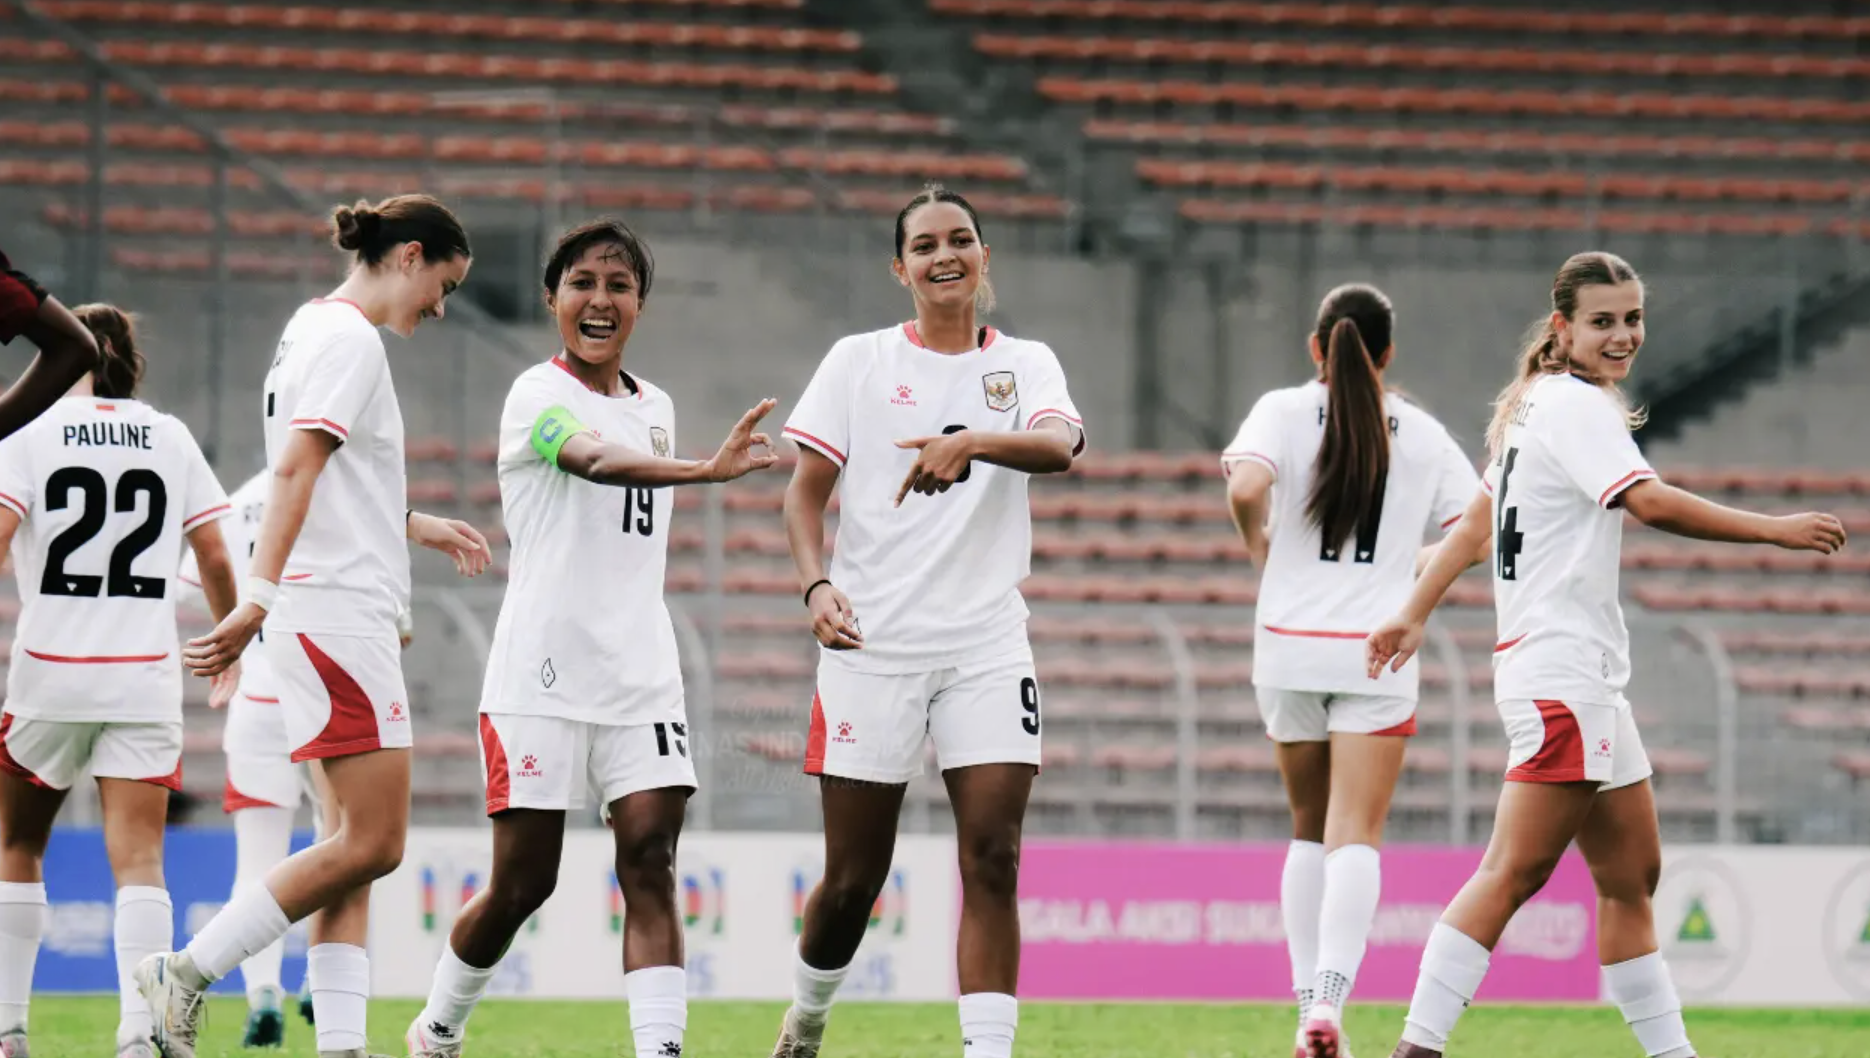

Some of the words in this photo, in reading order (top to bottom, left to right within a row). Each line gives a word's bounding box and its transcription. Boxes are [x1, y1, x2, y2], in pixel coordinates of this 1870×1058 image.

[890, 398, 917, 406] KELME
[63, 422, 152, 450] PAULINE
[540, 417, 563, 443] C
[622, 487, 653, 537] 19
[40, 466, 167, 599] 22
[1020, 677, 1040, 735] 9
